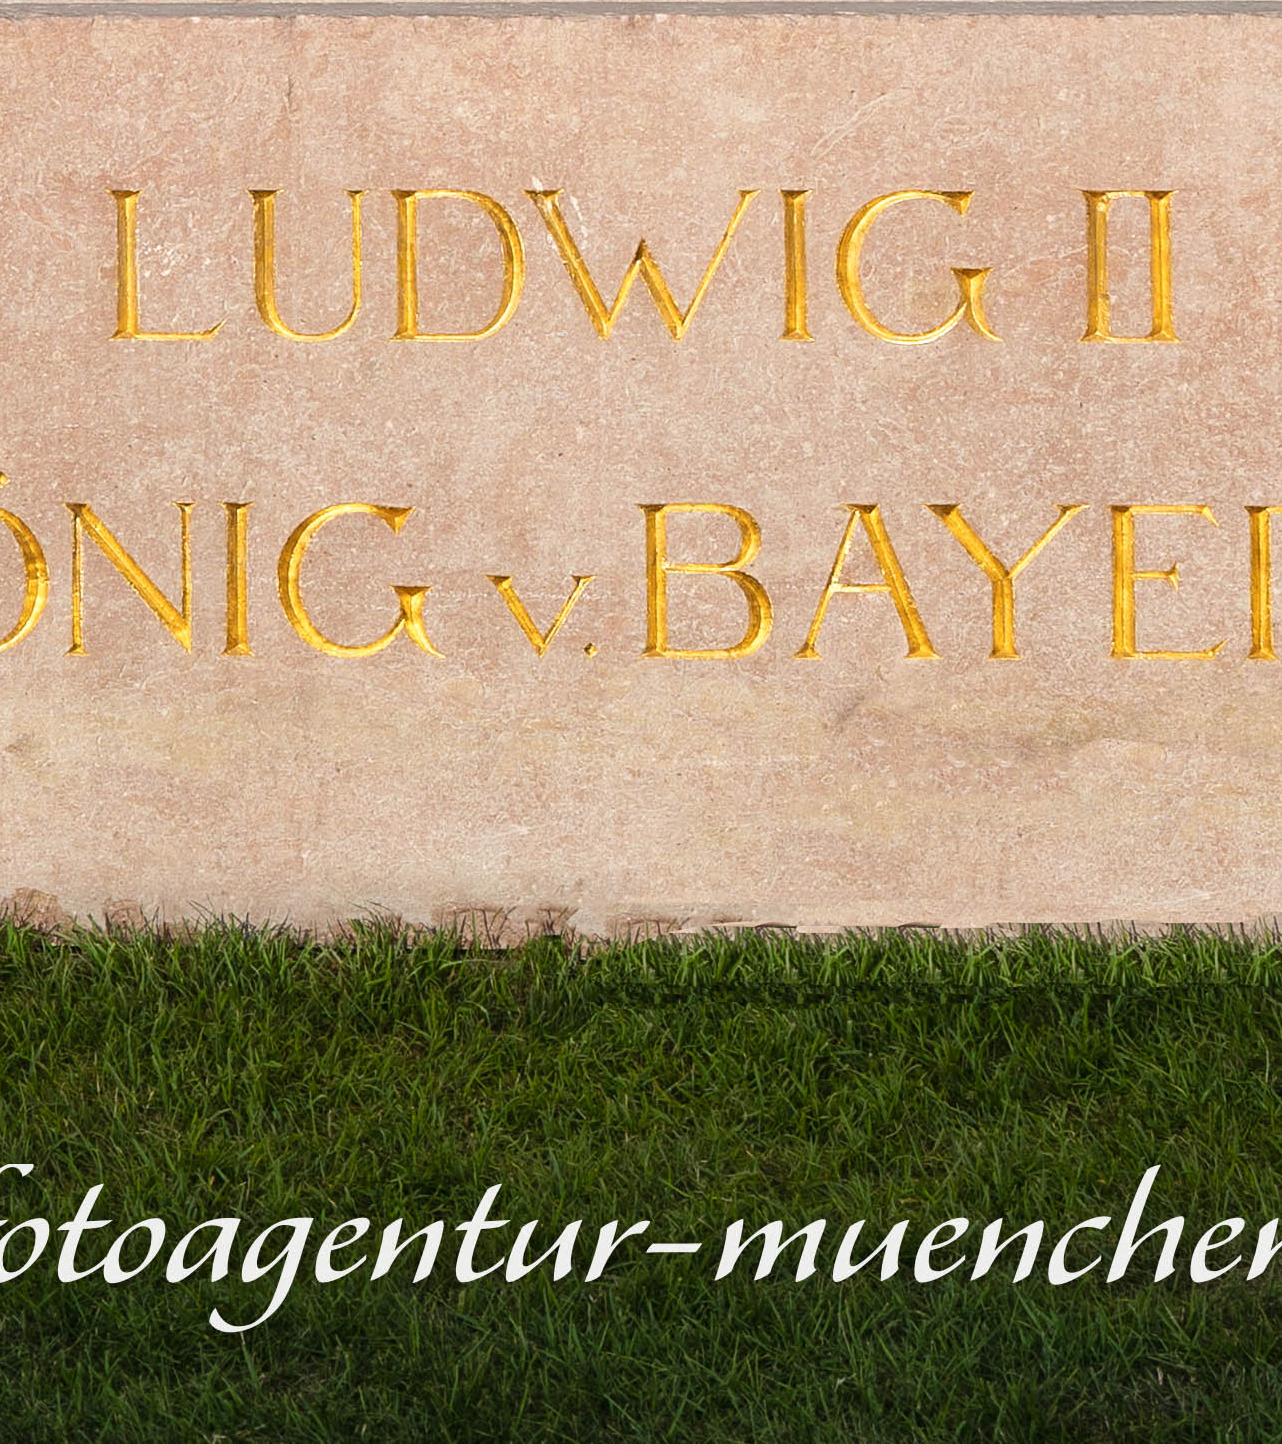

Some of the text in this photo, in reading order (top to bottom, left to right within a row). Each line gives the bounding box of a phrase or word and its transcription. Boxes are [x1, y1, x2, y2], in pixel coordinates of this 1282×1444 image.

[108, 187, 1180, 345] LUDWIG II
[483, 571, 598, 658] v.
